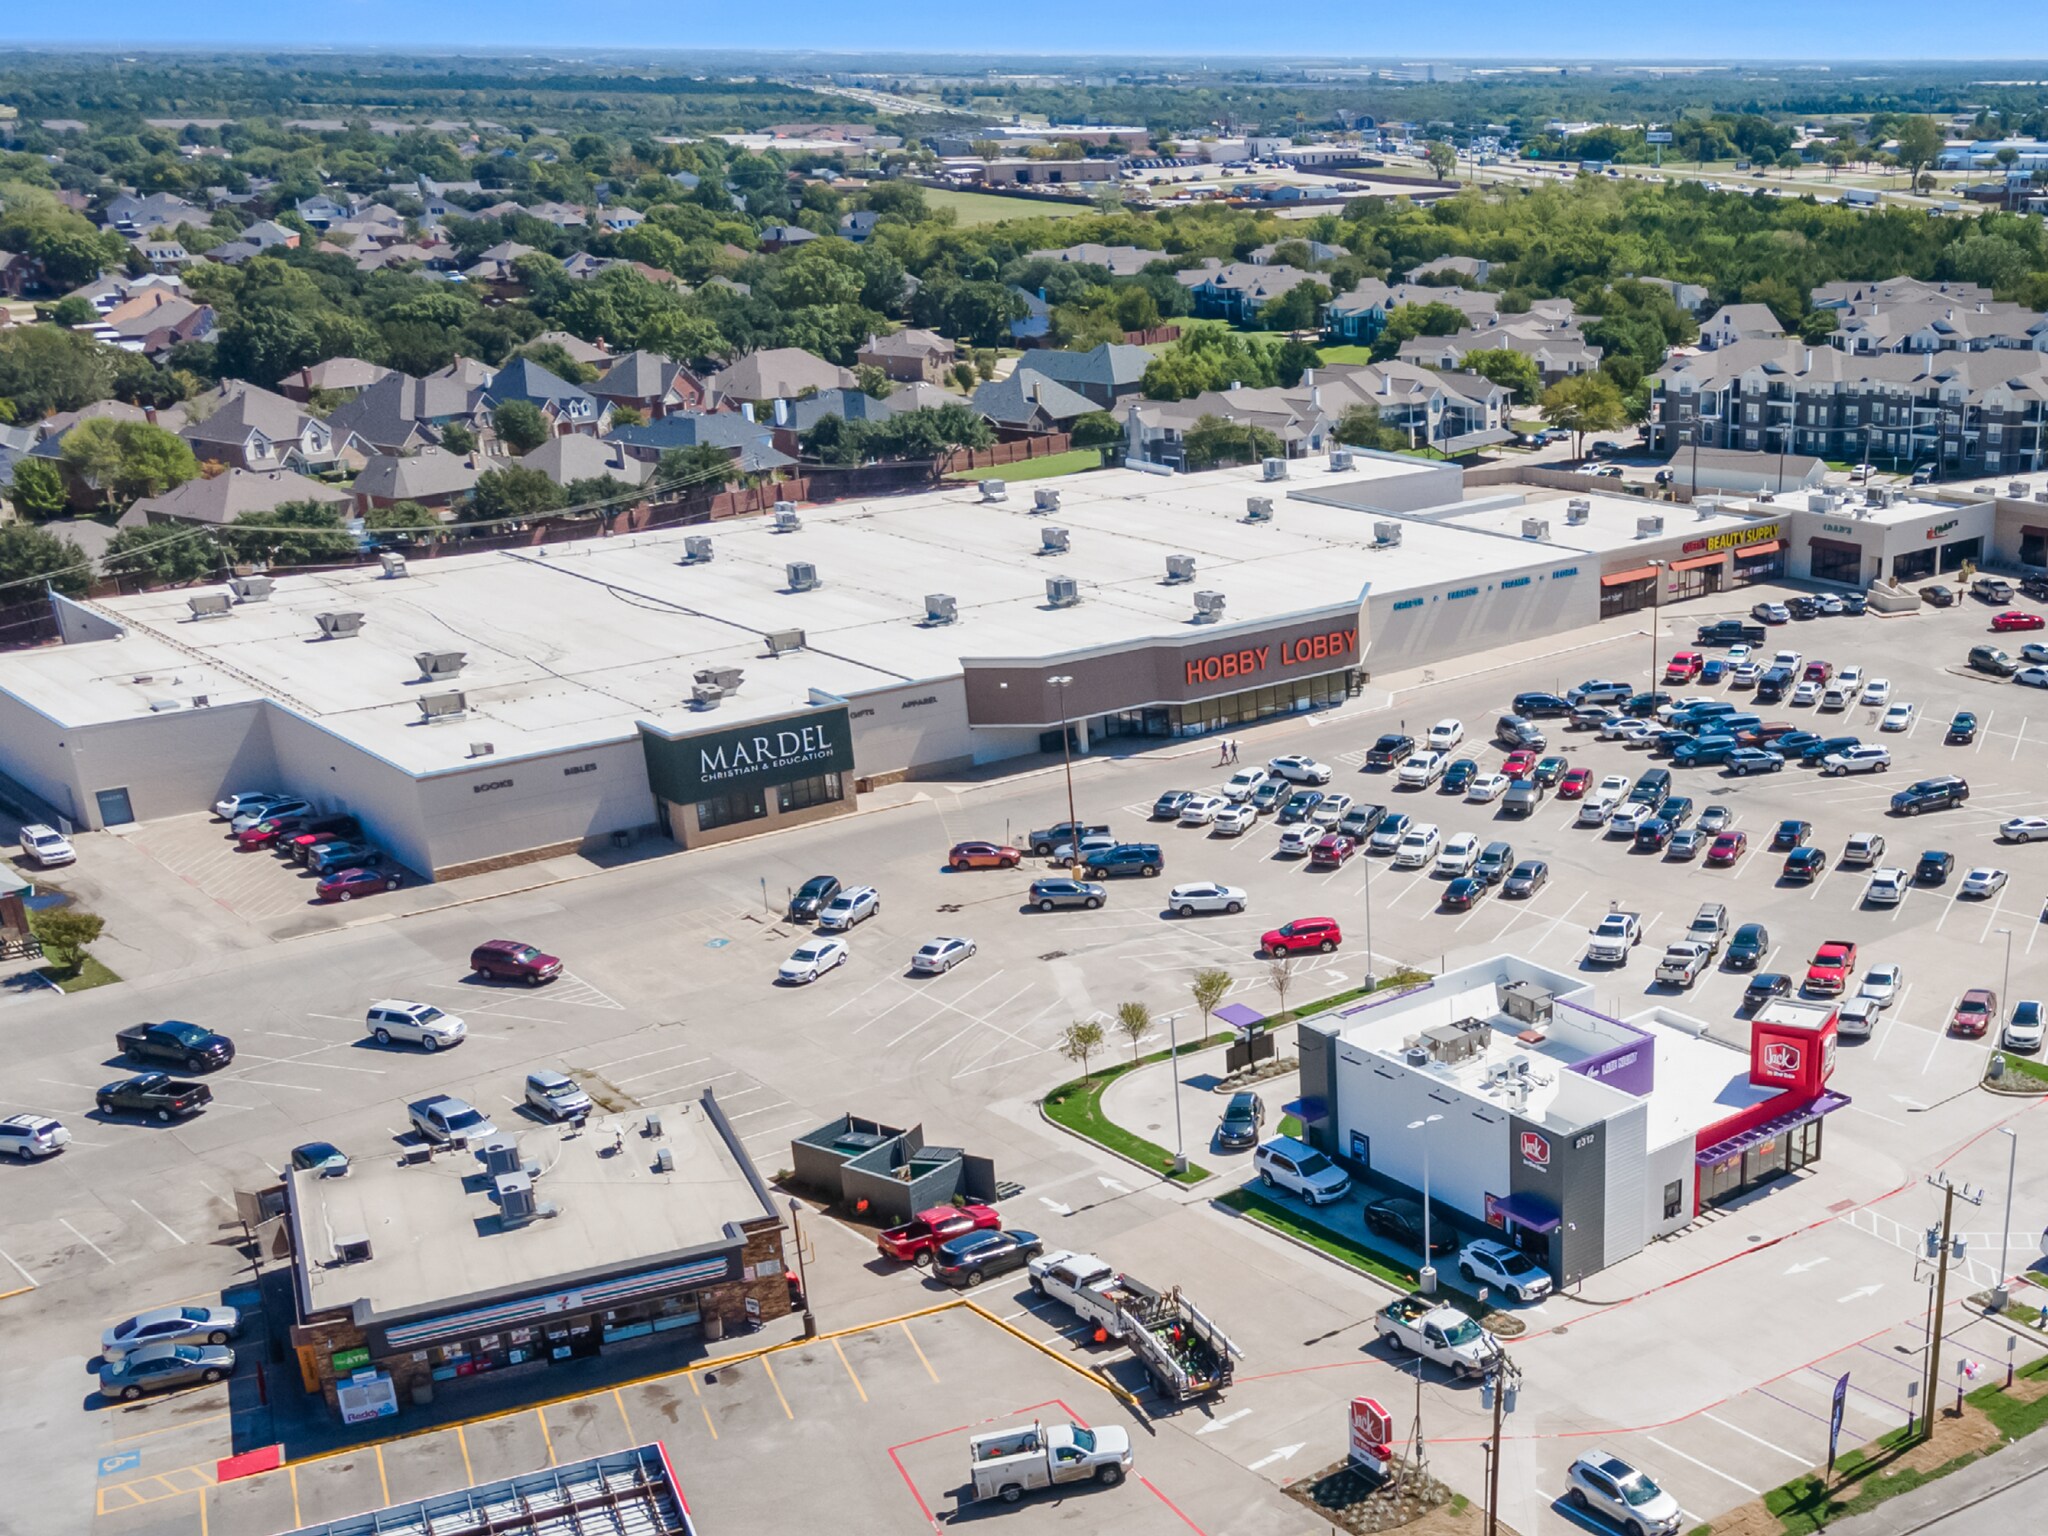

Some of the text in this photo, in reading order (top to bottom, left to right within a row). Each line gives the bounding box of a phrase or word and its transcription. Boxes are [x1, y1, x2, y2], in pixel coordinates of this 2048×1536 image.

[1707, 531, 1745, 551] BEAUTY
[1746, 523, 1779, 542] SUPPLY
[1186, 628, 1357, 685] HOBBY LOBBY
[850, 708, 875, 719] GIFTS
[901, 696, 938, 709] APPAREL
[701, 725, 832, 773] MARDEL
[564, 763, 597, 776] BIBLES
[701, 764, 758, 782] CHRISTIAN
[773, 749, 833, 768] EDUCATION
[473, 779, 514, 793] BOOKS
[1766, 1046, 1798, 1069] Jack
[1523, 1134, 1548, 1161] Jack
[1576, 1134, 1595, 1149] 2312
[346, 1353, 369, 1365] ATM
[1352, 1402, 1383, 1442] Jack
